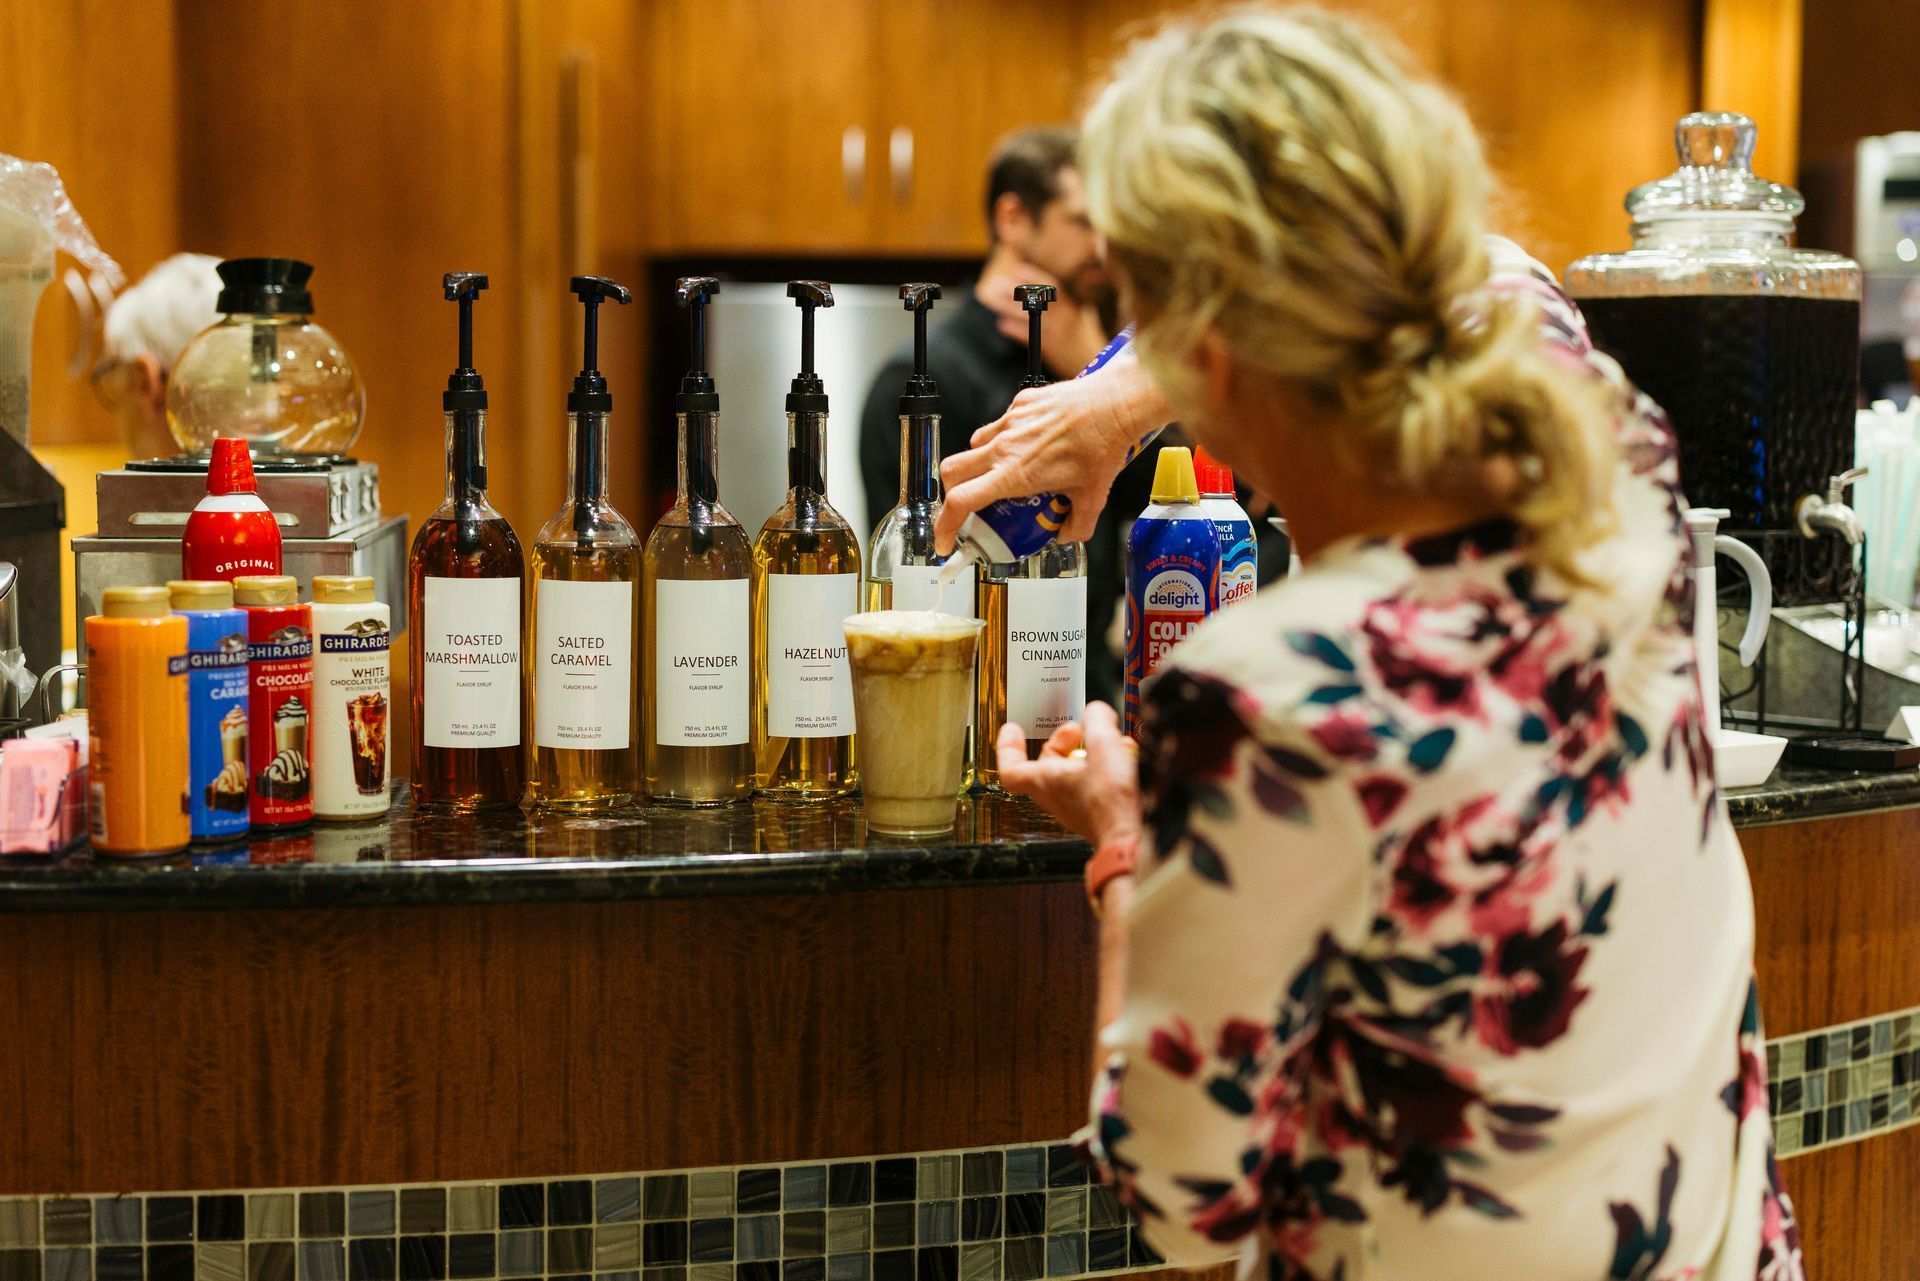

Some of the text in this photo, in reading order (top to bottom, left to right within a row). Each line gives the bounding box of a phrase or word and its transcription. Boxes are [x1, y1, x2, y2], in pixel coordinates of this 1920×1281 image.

[216, 559, 274, 573] ORIGINAL
[1150, 592, 1199, 608] delight
[446, 634, 503, 646] TOASTED
[558, 636, 604, 649] SALTED
[1011, 631, 1058, 642] BROWN
[248, 643, 312, 657] GHIRARDE
[785, 647, 847, 660] HAZELNUT
[1022, 649, 1082, 660] CINNAMON
[425, 652, 518, 665] MARSHMALLOW
[550, 653, 612, 666] CARAMEL
[674, 656, 738, 668] LAVENDER
[352, 666, 384, 678] WHITE
